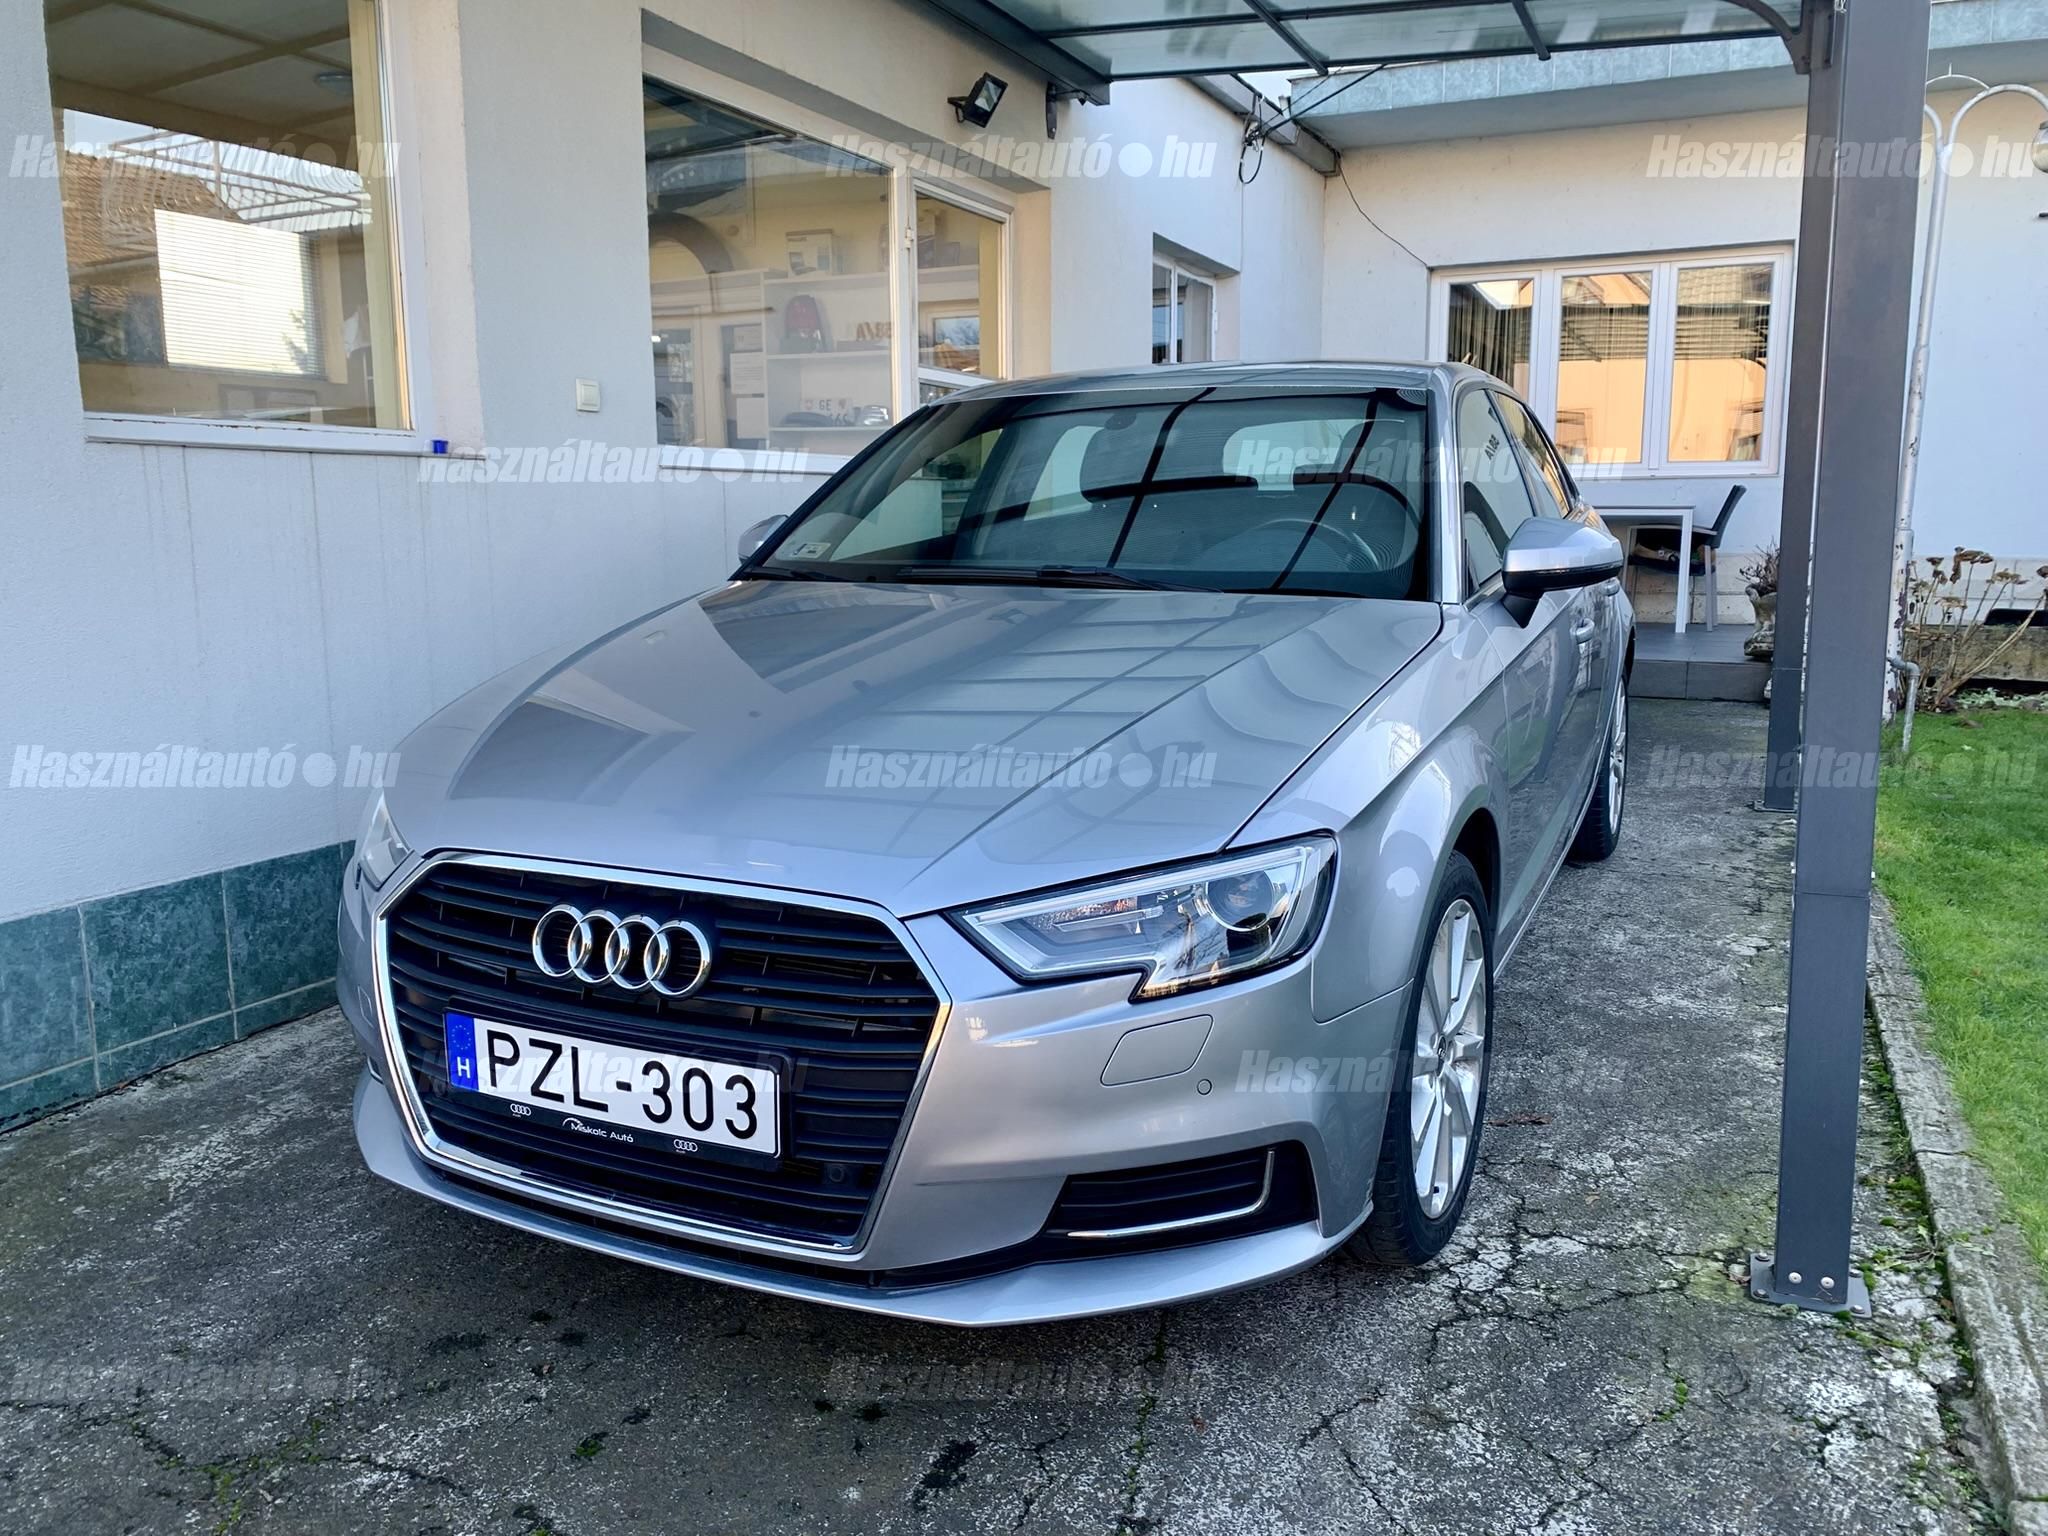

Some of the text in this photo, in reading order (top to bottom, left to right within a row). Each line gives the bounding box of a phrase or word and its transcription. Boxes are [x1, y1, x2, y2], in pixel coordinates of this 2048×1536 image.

[457, 1055, 471, 1080] H
[487, 1028, 758, 1140] PZL-303
[570, 1120, 634, 1143] Miskolc Autó
